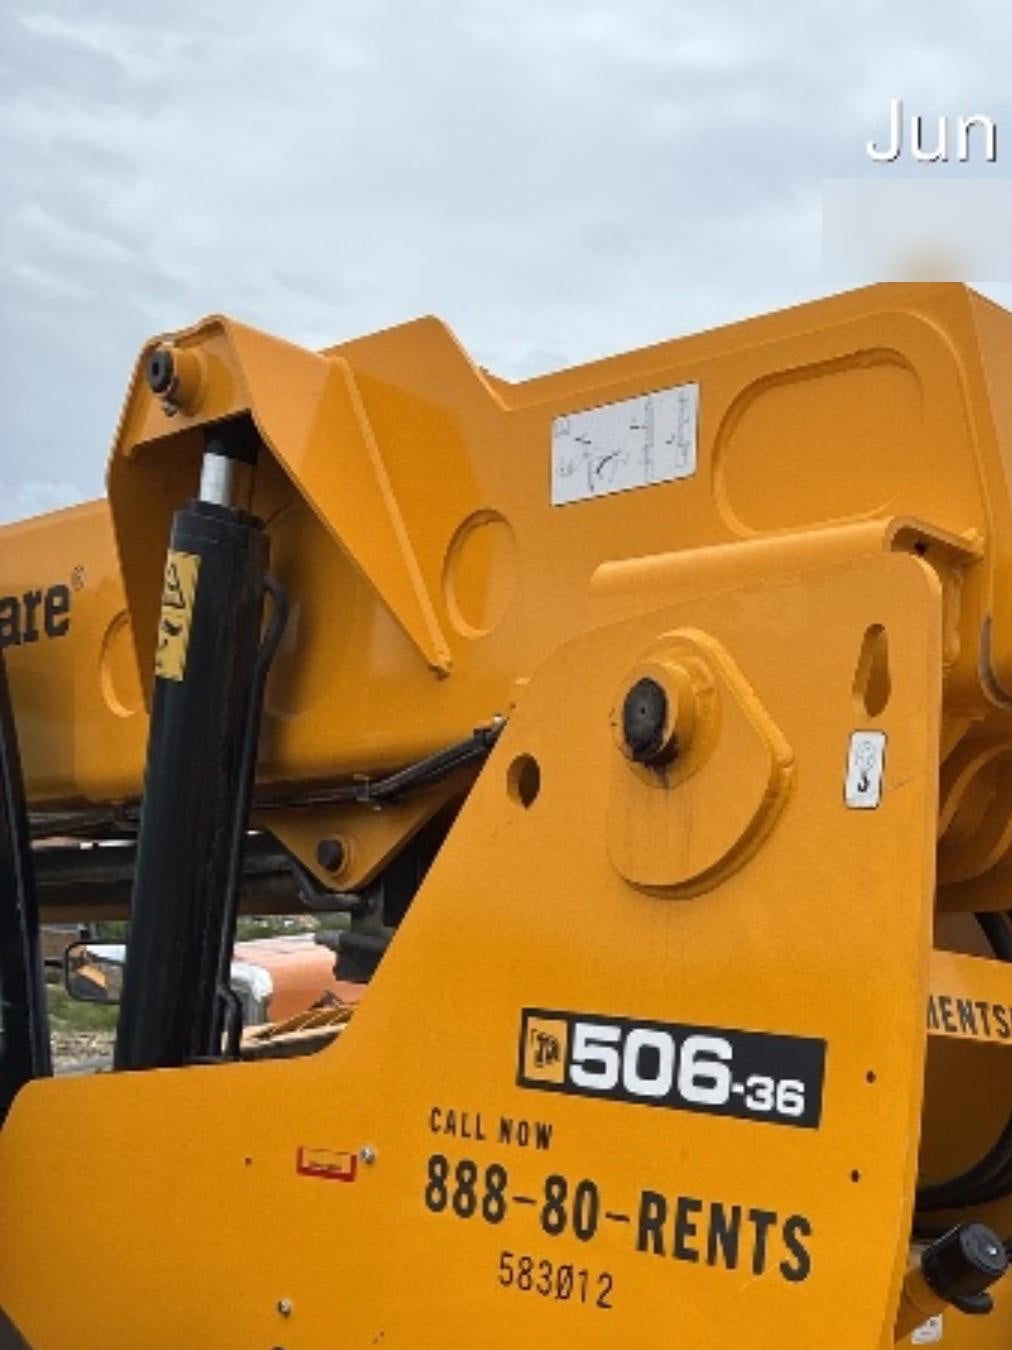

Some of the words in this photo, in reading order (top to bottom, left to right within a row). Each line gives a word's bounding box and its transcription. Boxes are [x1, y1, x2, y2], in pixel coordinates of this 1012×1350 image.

[569, 1022, 805, 1116] 506-36
[430, 1106, 486, 1141] CALL
[499, 1118, 554, 1150] NOW
[425, 1154, 811, 1282] 888-80-RENTS
